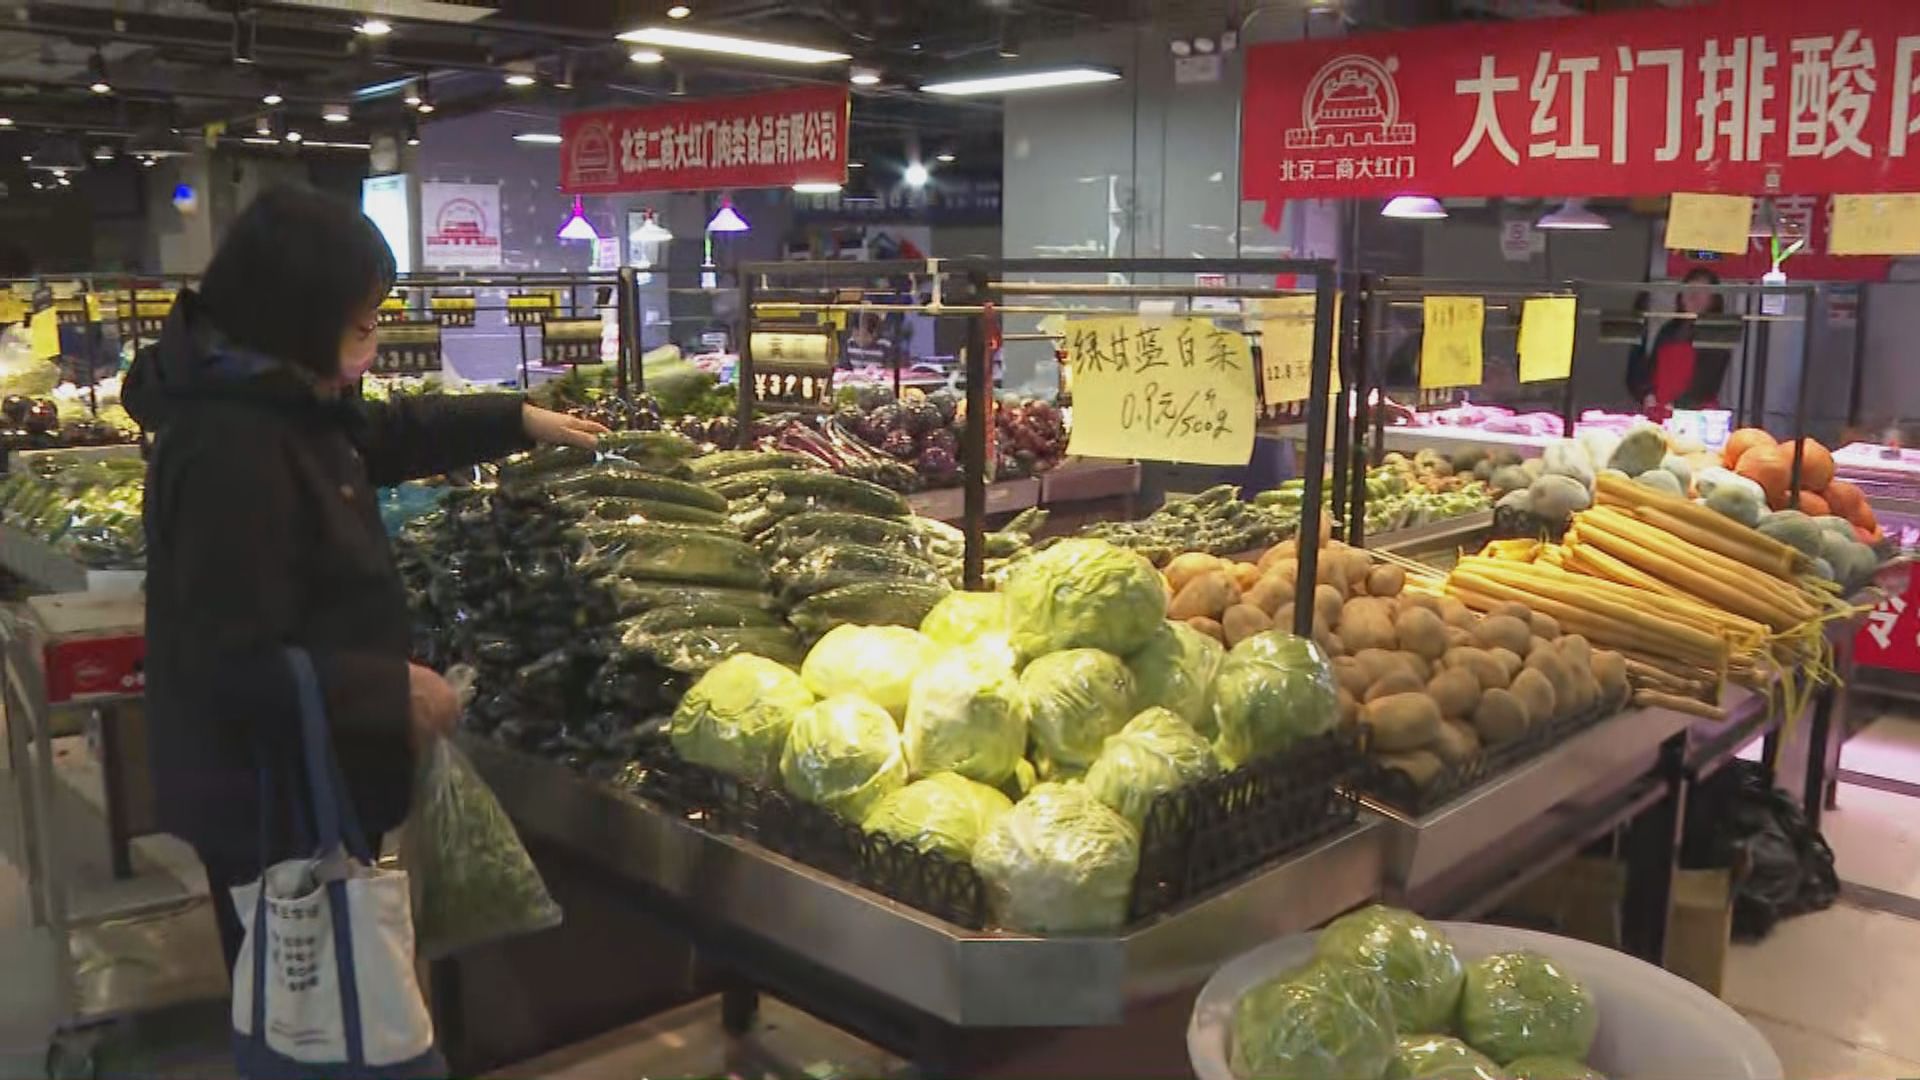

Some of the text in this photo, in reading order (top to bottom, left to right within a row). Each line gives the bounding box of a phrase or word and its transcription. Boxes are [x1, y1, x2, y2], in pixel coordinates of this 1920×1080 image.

[620, 111, 836, 174] 北京二商大红门肉类食品有限公司
[1280, 156, 1415, 181] 北京二商大红门
